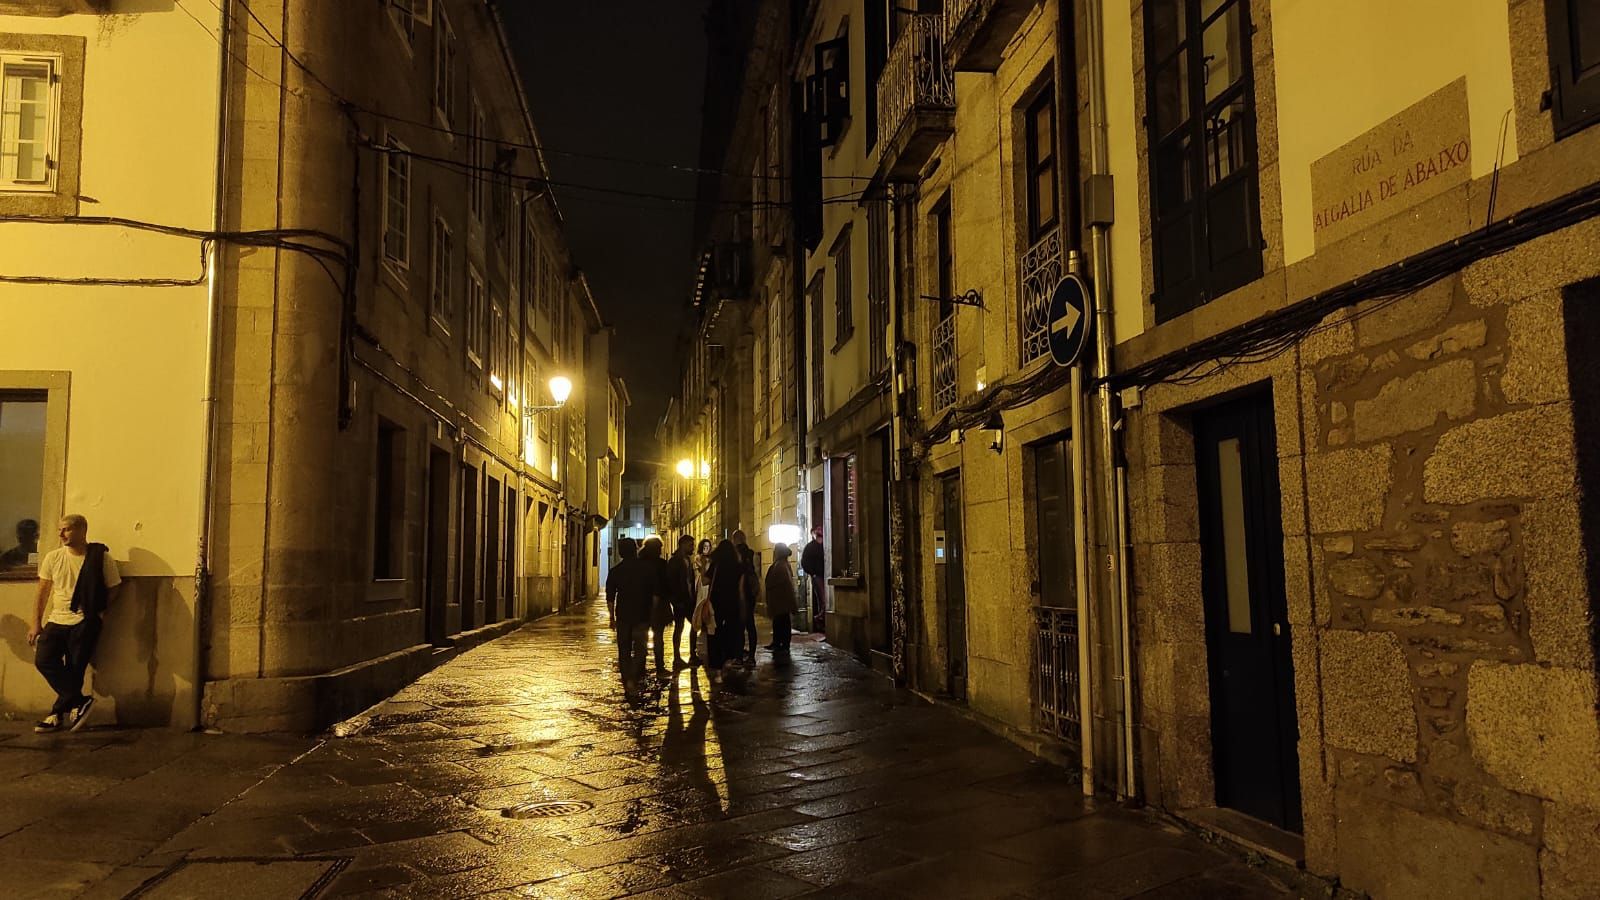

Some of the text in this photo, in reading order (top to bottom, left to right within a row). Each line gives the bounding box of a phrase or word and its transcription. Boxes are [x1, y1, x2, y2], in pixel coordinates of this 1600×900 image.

[1392, 130, 1414, 156] DA
[1379, 174, 1398, 201] DE
[1403, 140, 1469, 190] ABAIXO
